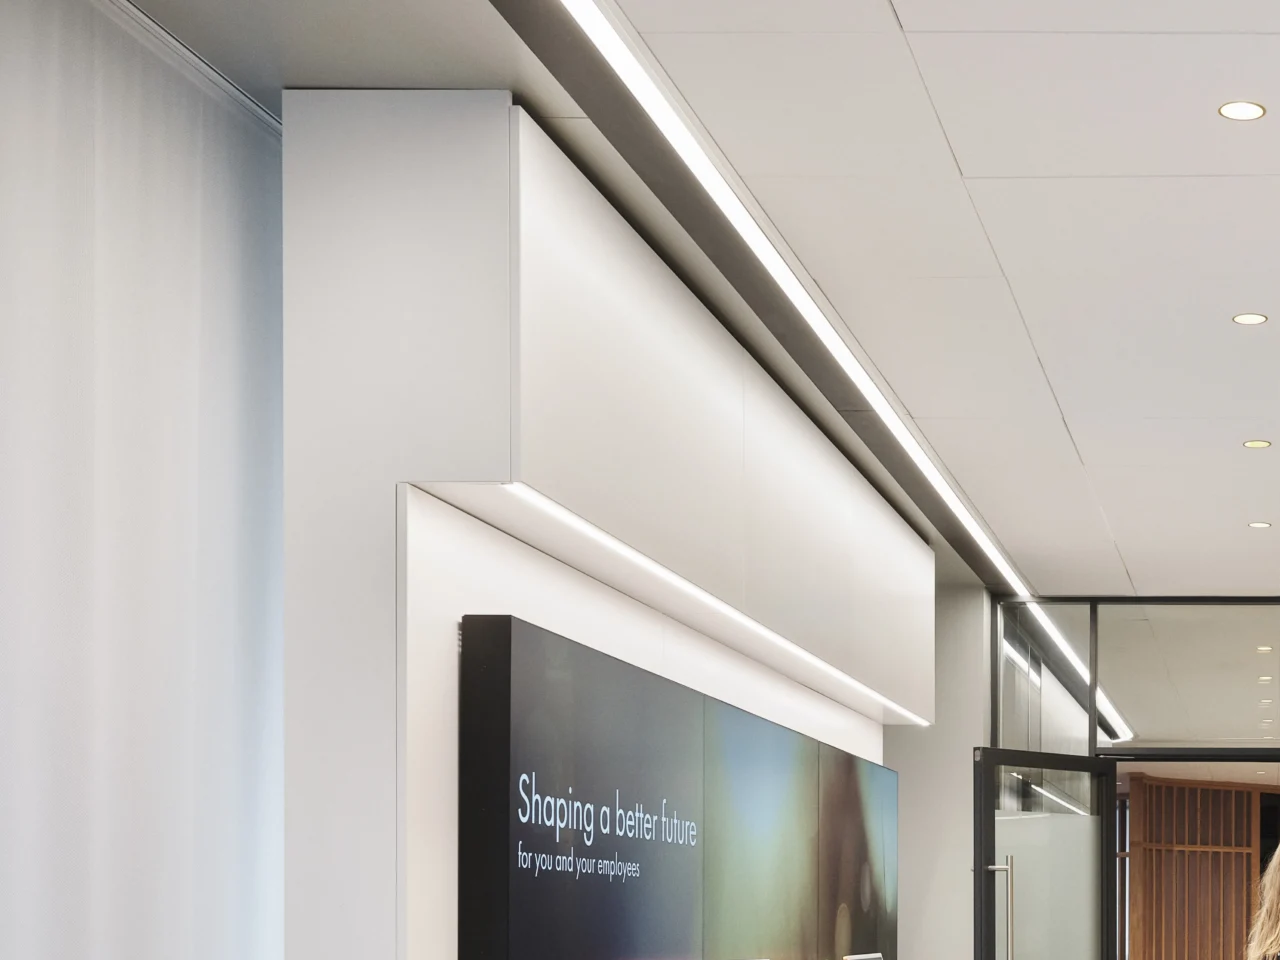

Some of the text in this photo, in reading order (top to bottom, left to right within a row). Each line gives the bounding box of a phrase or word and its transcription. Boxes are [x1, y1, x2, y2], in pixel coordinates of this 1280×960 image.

[518, 771, 697, 847] Shaping a better future
[518, 841, 640, 883] for you and your employees
